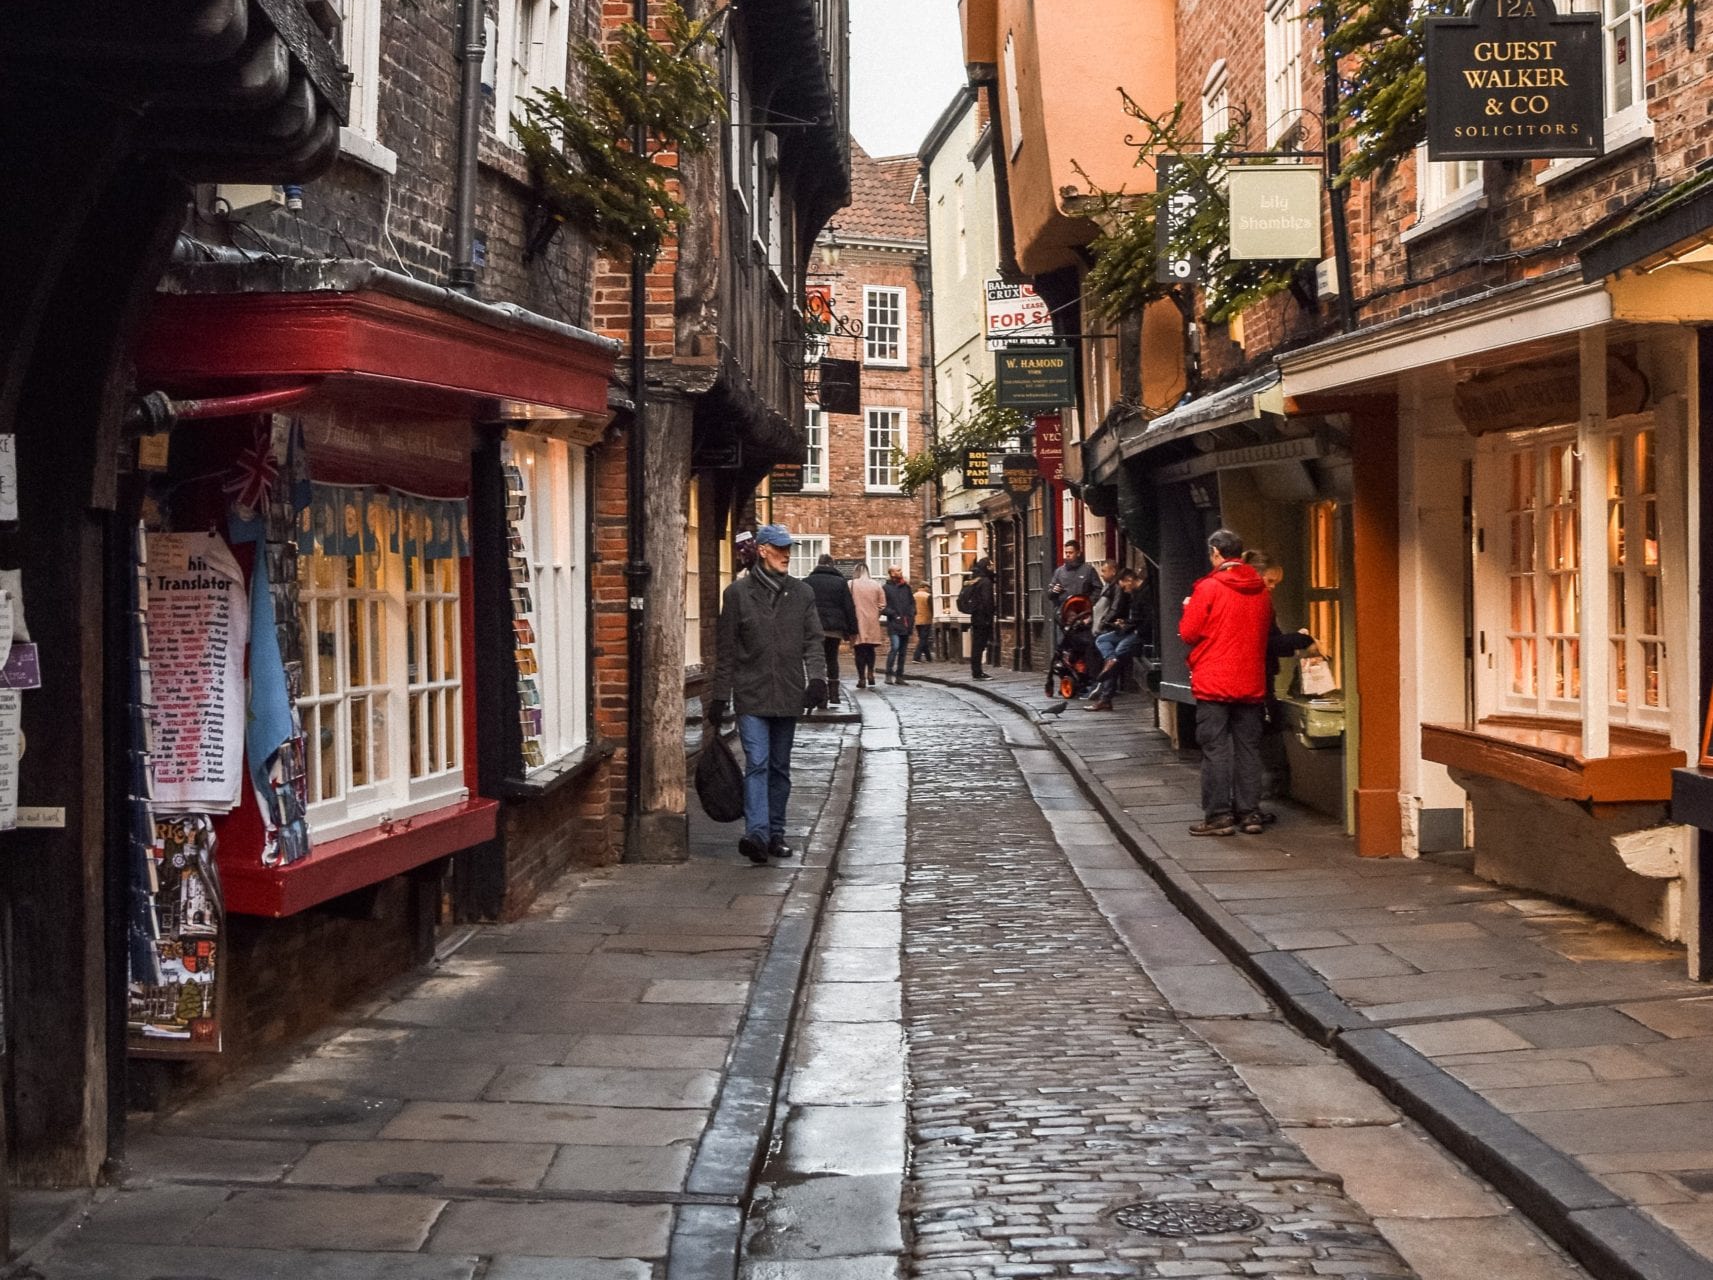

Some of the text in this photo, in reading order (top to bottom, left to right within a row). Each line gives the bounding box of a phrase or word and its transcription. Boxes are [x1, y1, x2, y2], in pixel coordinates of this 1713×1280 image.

[1474, 41, 1557, 62] GUEST
[1462, 68, 1569, 89] WALKER
[1485, 95, 1549, 116] & CO
[1454, 123, 1579, 138] SOLICITORS
[1260, 195, 1289, 211] Lily
[1239, 216, 1312, 230] Shambles
[988, 289, 1020, 300] CRUX
[990, 311, 1052, 328] FOR SA
[1020, 358, 1064, 368] HAMOND
[1042, 433, 1062, 441] VEC
[158, 575, 233, 591] Translator
